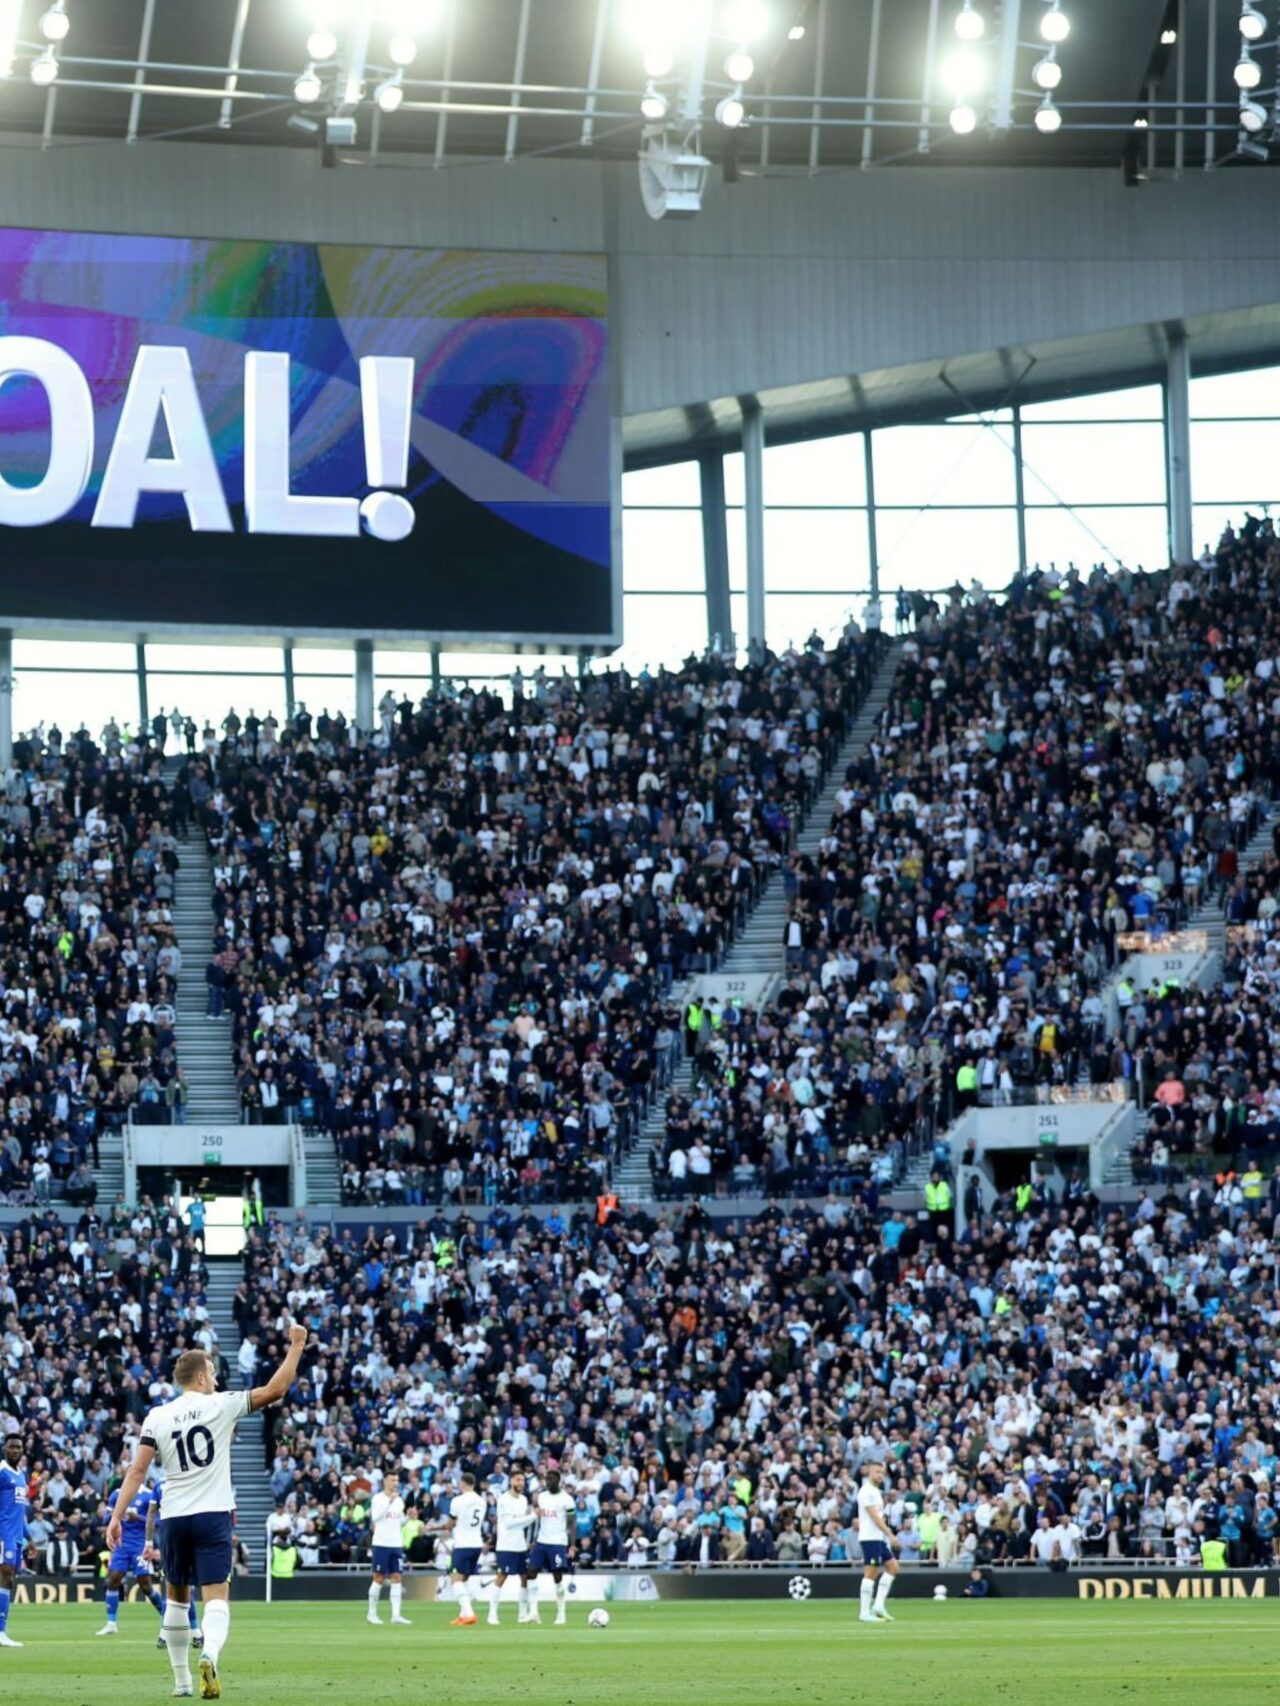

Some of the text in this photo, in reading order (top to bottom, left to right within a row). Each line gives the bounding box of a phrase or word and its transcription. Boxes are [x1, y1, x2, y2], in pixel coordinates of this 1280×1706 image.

[201, 1135, 223, 1147] 250
[171, 1425, 215, 1472] 10
[470, 1508, 481, 1528] 5
